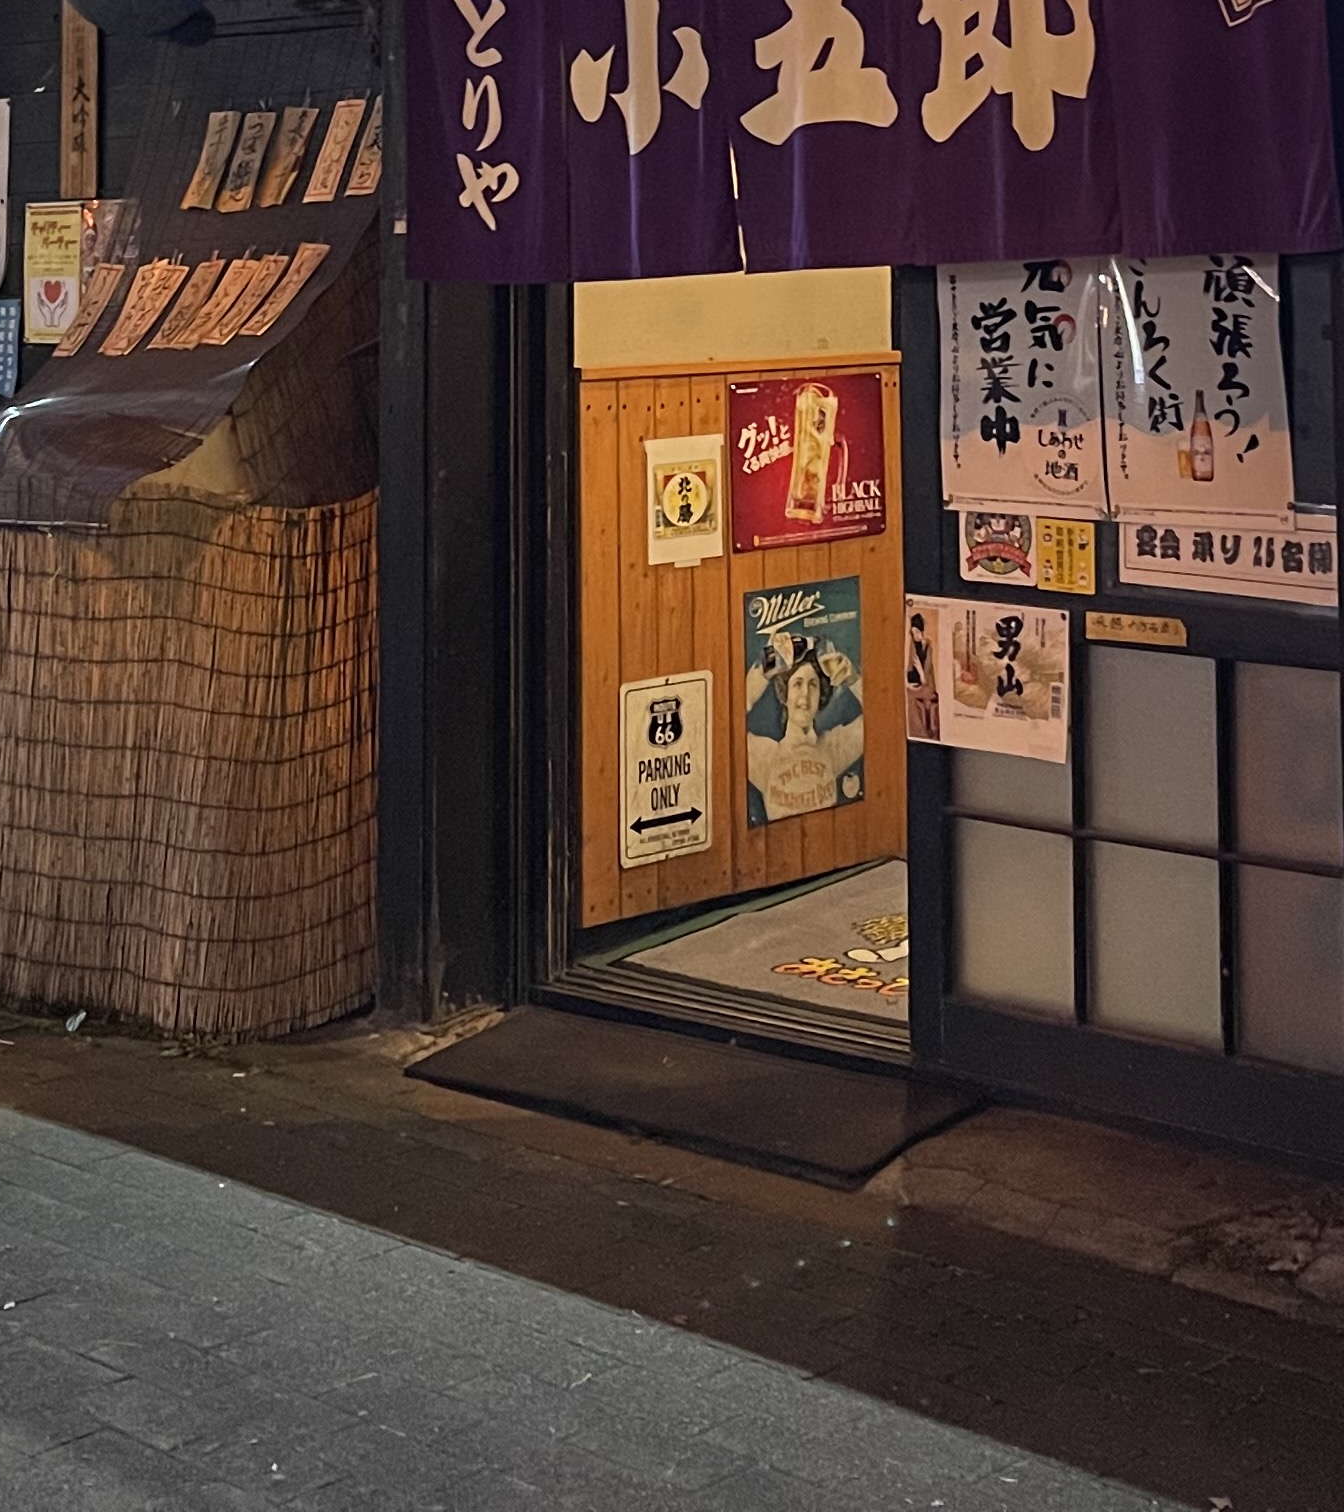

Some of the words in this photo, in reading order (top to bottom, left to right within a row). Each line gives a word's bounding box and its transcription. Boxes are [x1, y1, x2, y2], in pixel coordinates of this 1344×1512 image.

[971, 297, 1022, 457] 営業中
[832, 480, 880, 501] BLACK
[755, 591, 820, 629] Miller
[994, 615, 1023, 697] 男山
[655, 725, 674, 744] 66
[639, 753, 690, 783] PARKING
[651, 783, 680, 811] ONLY
